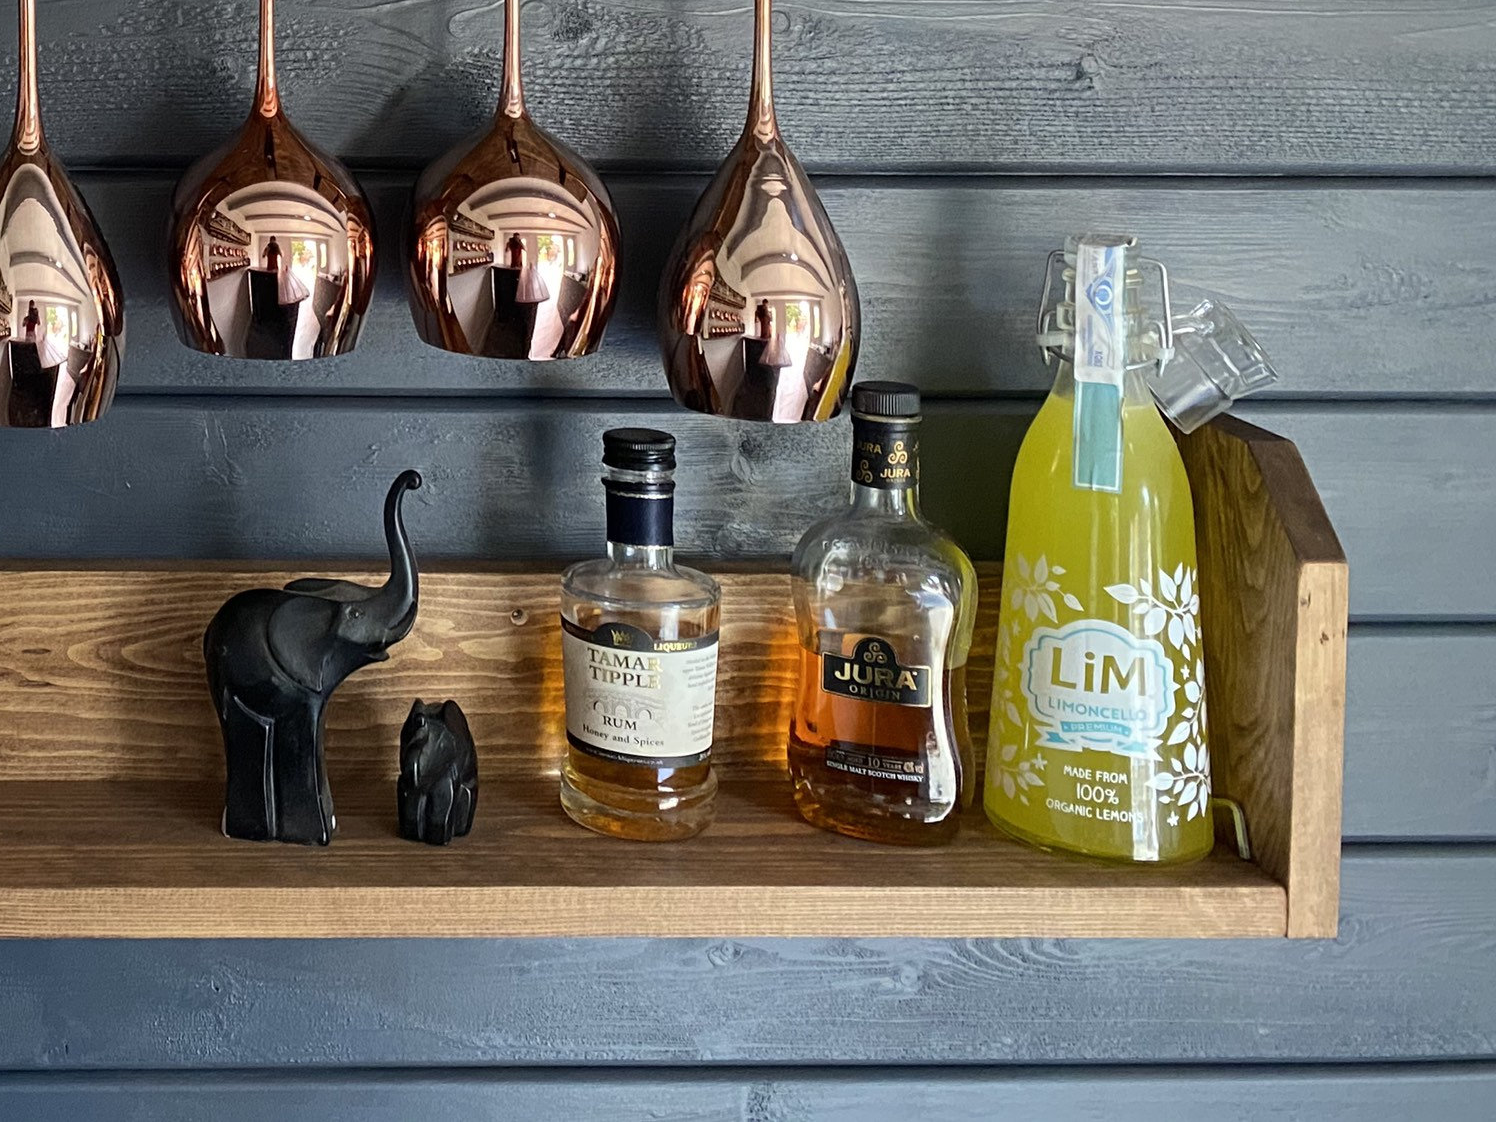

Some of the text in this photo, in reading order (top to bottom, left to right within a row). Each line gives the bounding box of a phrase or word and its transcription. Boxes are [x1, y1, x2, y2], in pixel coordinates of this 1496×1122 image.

[880, 468, 911, 478] JURA
[587, 647, 663, 672] TAMAR
[589, 665, 661, 689] TIPPLE
[835, 662, 917, 691] JURA
[1051, 647, 1146, 696] LiM
[849, 684, 901, 700] ORIGIN
[1048, 697, 1147, 720] LIMONCELLO
[602, 715, 637, 730] RUM
[1070, 722, 1123, 733] PREMIUM
[583, 724, 664, 747] Honey and Spices
[868, 757, 880, 768] 10
[849, 766, 866, 776] MALT
[868, 769, 896, 780] SCOTCH
[897, 774, 924, 783] WHISKY
[1063, 765, 1128, 784] MADE FROM
[1076, 783, 1119, 805] 100%
[1046, 798, 1144, 823] ORGANIC LEMONS
